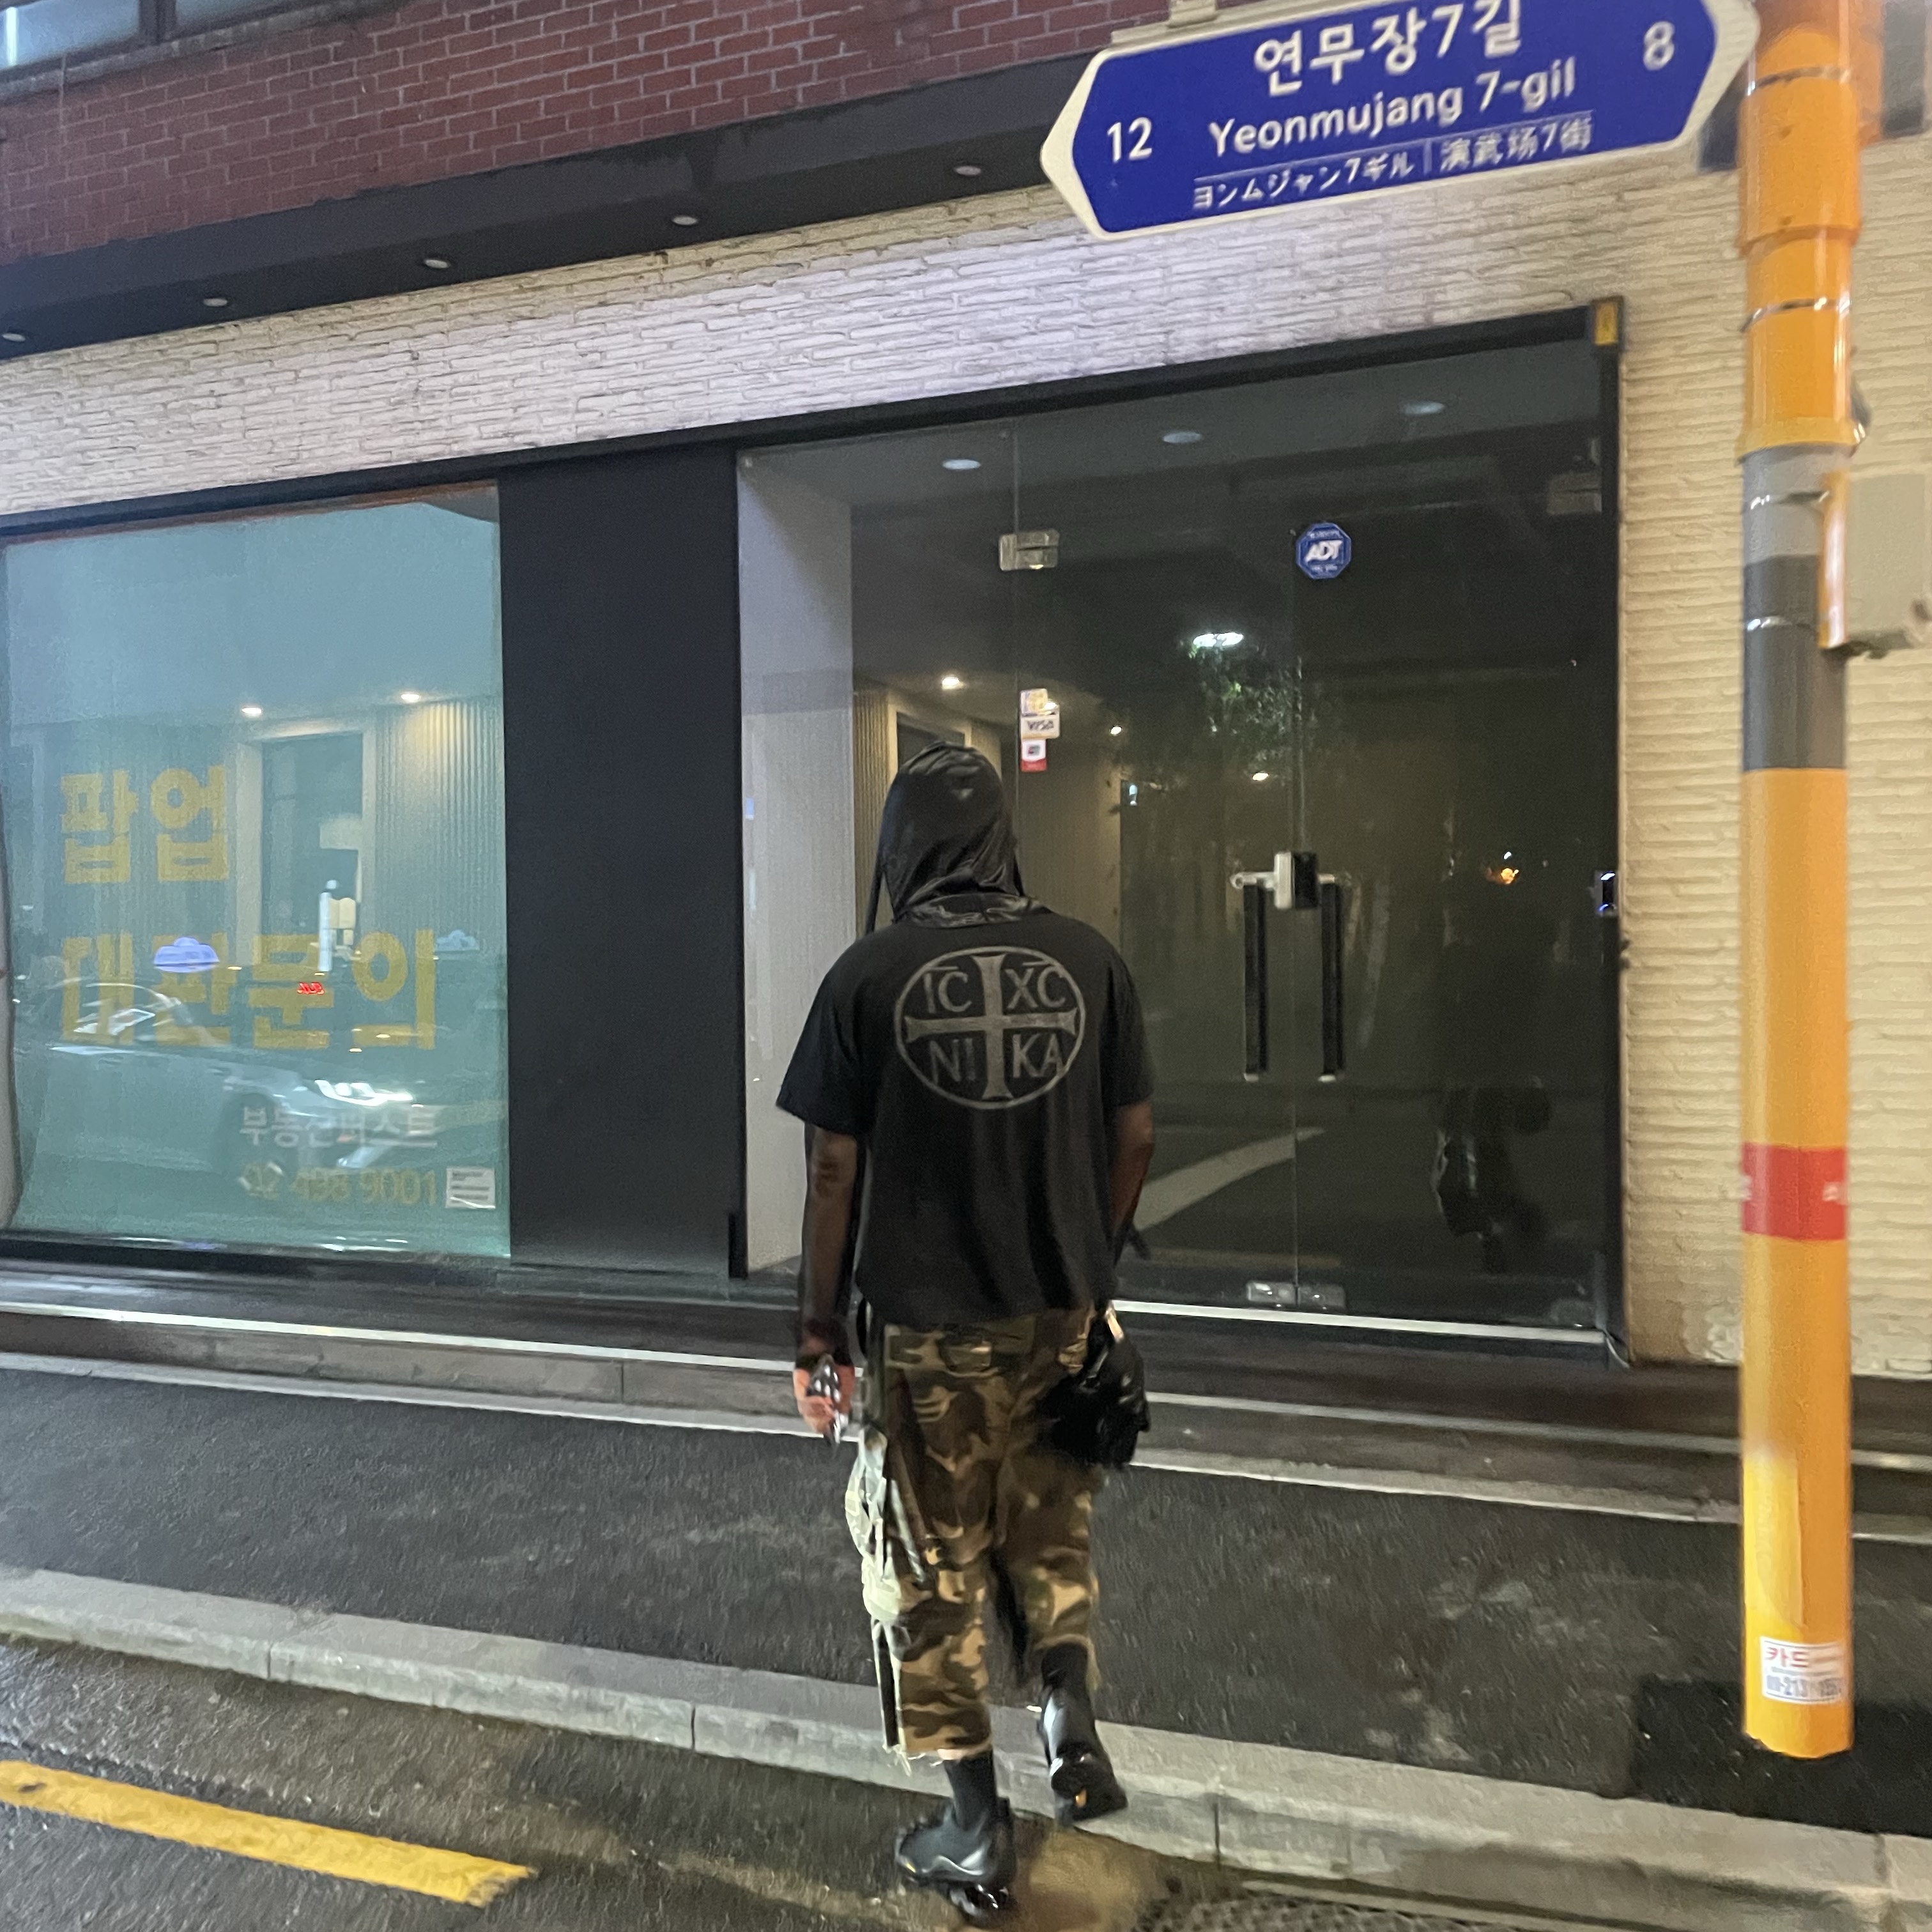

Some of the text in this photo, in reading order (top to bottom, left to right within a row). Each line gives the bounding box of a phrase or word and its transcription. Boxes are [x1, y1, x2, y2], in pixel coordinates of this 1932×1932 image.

[1254, 0, 1521, 96] 연무장7길
[1643, 21, 1675, 70] 8
[1209, 56, 1576, 157] Yeonmujang 7-gil
[1107, 116, 1153, 164] 12
[1304, 539, 1343, 563] ADT
[62, 765, 230, 884] 팝업
[1004, 965, 1066, 1009] XC
